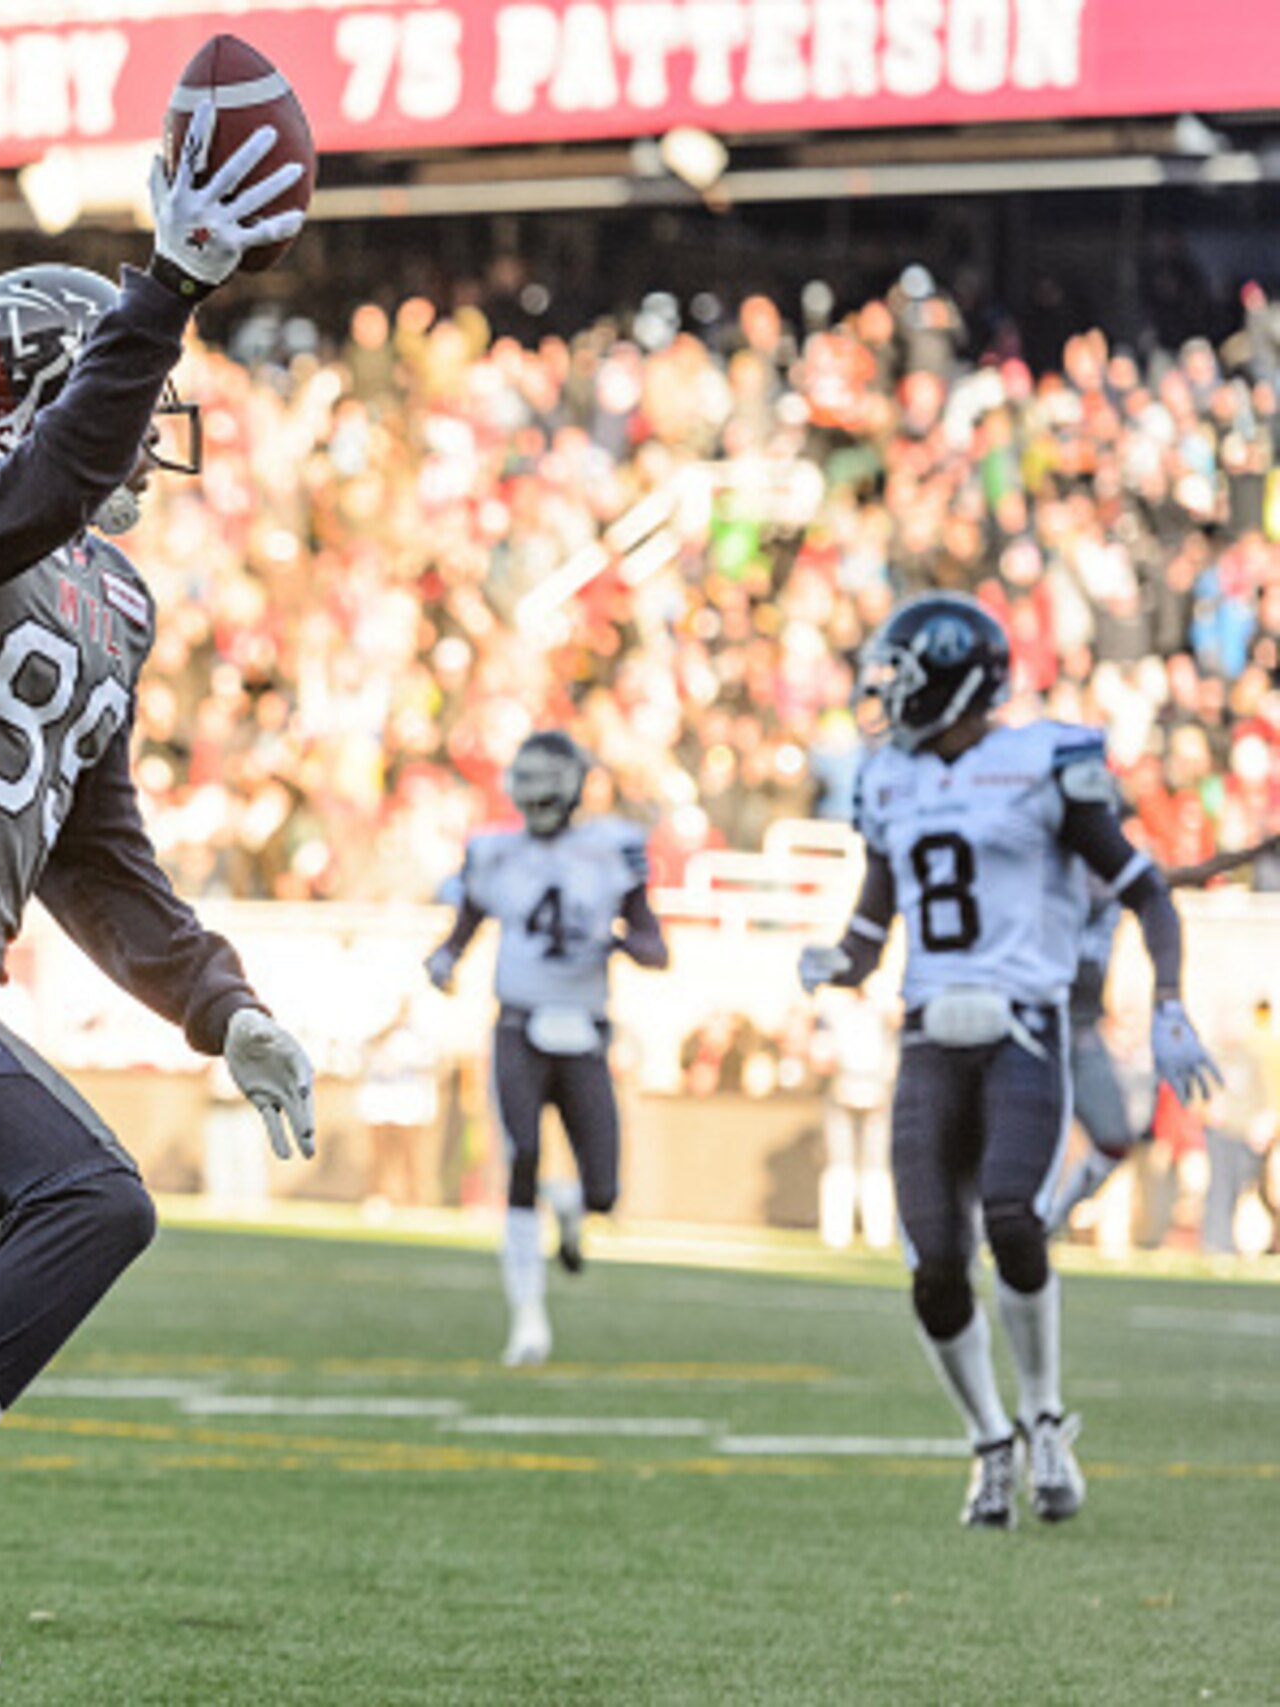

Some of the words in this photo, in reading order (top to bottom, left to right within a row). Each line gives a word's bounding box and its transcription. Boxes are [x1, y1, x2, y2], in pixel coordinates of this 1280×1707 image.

[335, 10, 464, 123] 75
[492, 0, 1086, 115] PATTERSON
[58, 576, 121, 657] MTL
[524, 885, 566, 959] 4
[911, 831, 981, 953] 8
